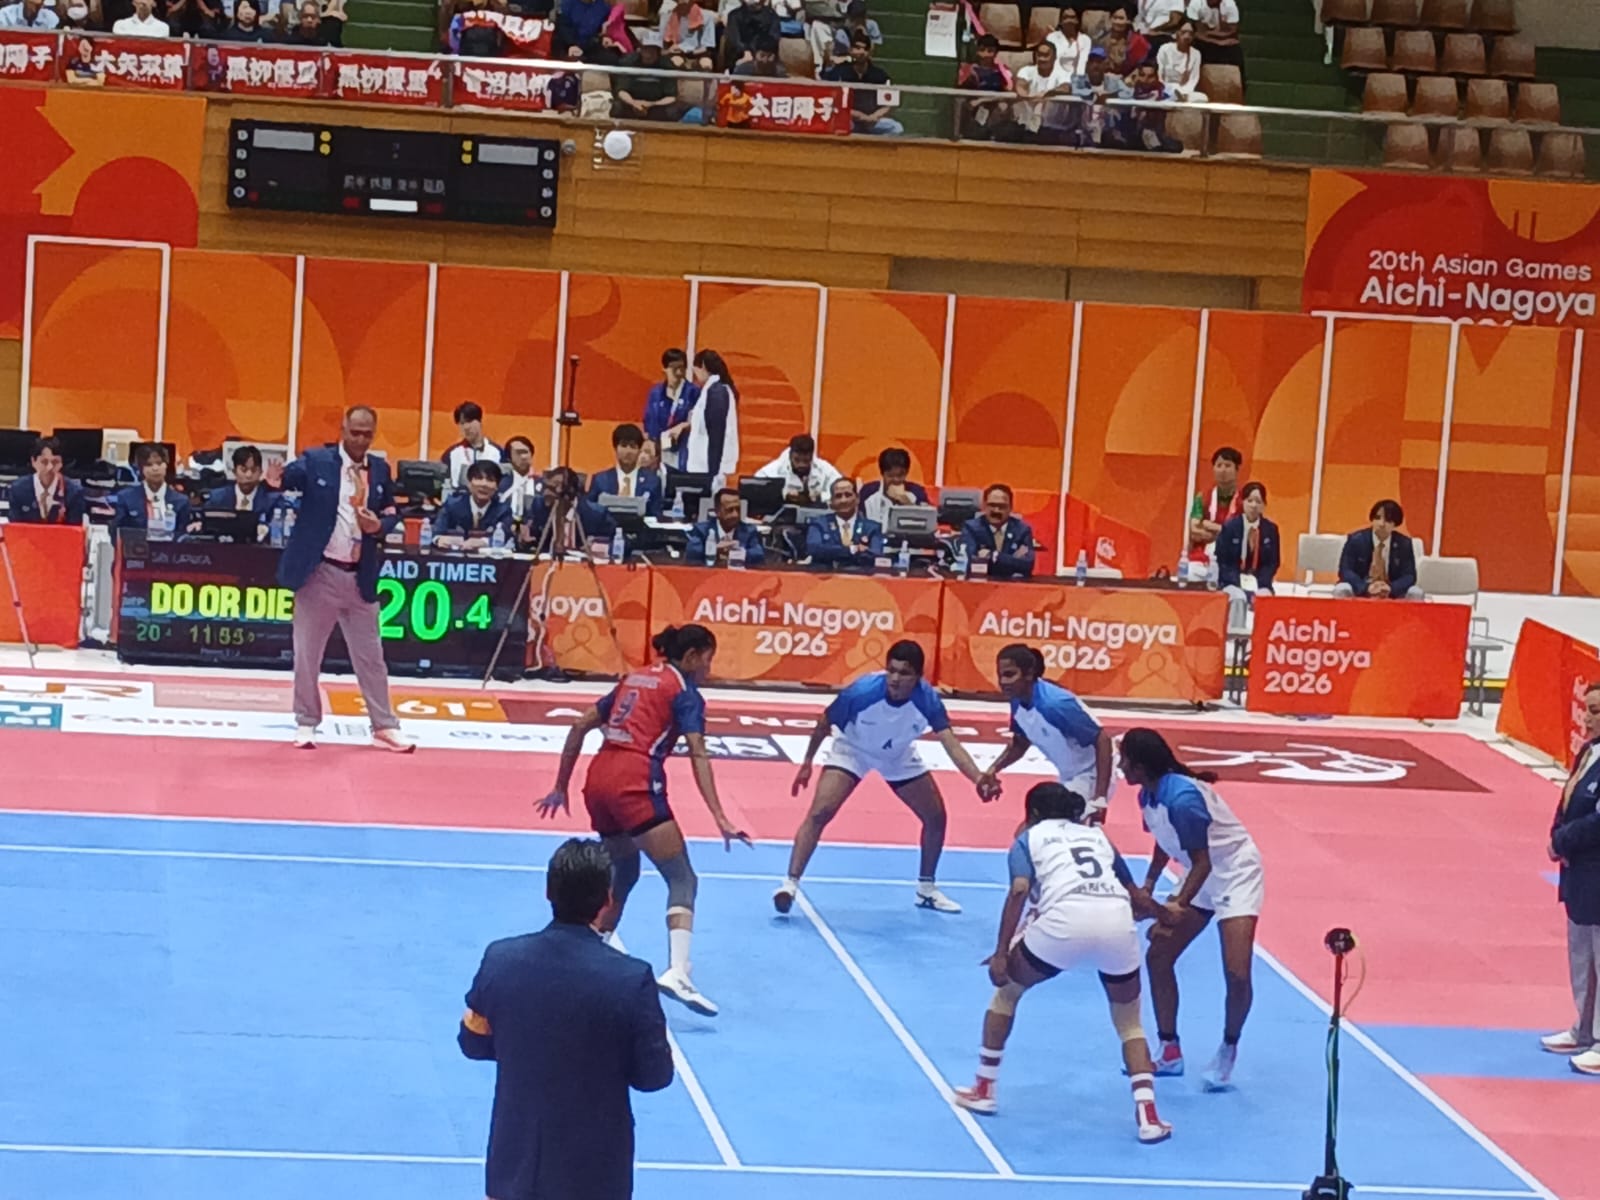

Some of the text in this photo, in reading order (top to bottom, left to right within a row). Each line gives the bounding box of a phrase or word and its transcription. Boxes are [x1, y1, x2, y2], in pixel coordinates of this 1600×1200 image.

[1368, 250, 1592, 281] 20th Asian Games
[1359, 274, 1596, 324] Aichi-Nagoya
[428, 562, 497, 583] TIMER
[151, 582, 295, 621] DO OR DIE
[694, 597, 895, 637] Aichi-Nagoya
[755, 630, 828, 657] 2026
[978, 609, 1178, 649] Aichi-Nagoya
[1268, 618, 1350, 643] Aichi-
[1043, 644, 1112, 671] 2026
[1265, 643, 1372, 674] Nagoya
[1263, 671, 1332, 695] 2026
[1070, 846, 1103, 879] 5
